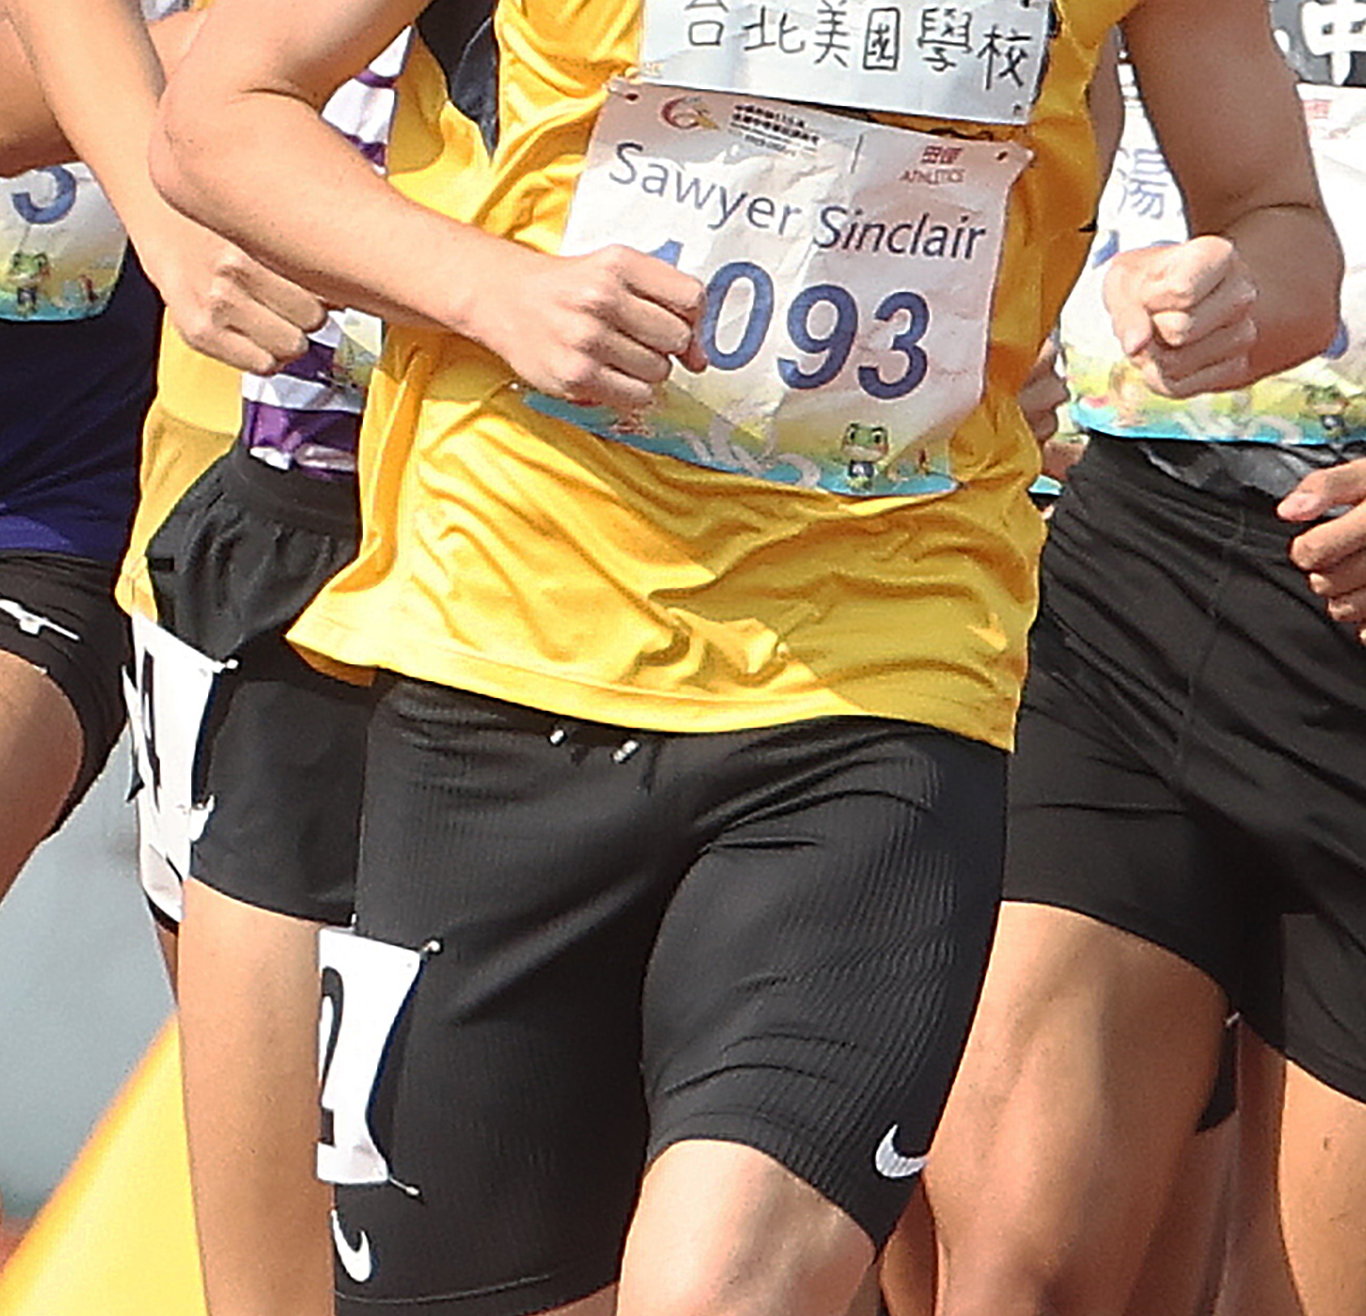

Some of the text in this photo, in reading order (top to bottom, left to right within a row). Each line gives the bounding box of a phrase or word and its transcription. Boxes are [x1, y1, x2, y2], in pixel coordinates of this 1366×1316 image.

[608, 142, 986, 260] Sawyer Sinclair
[647, 239, 930, 401] 093
